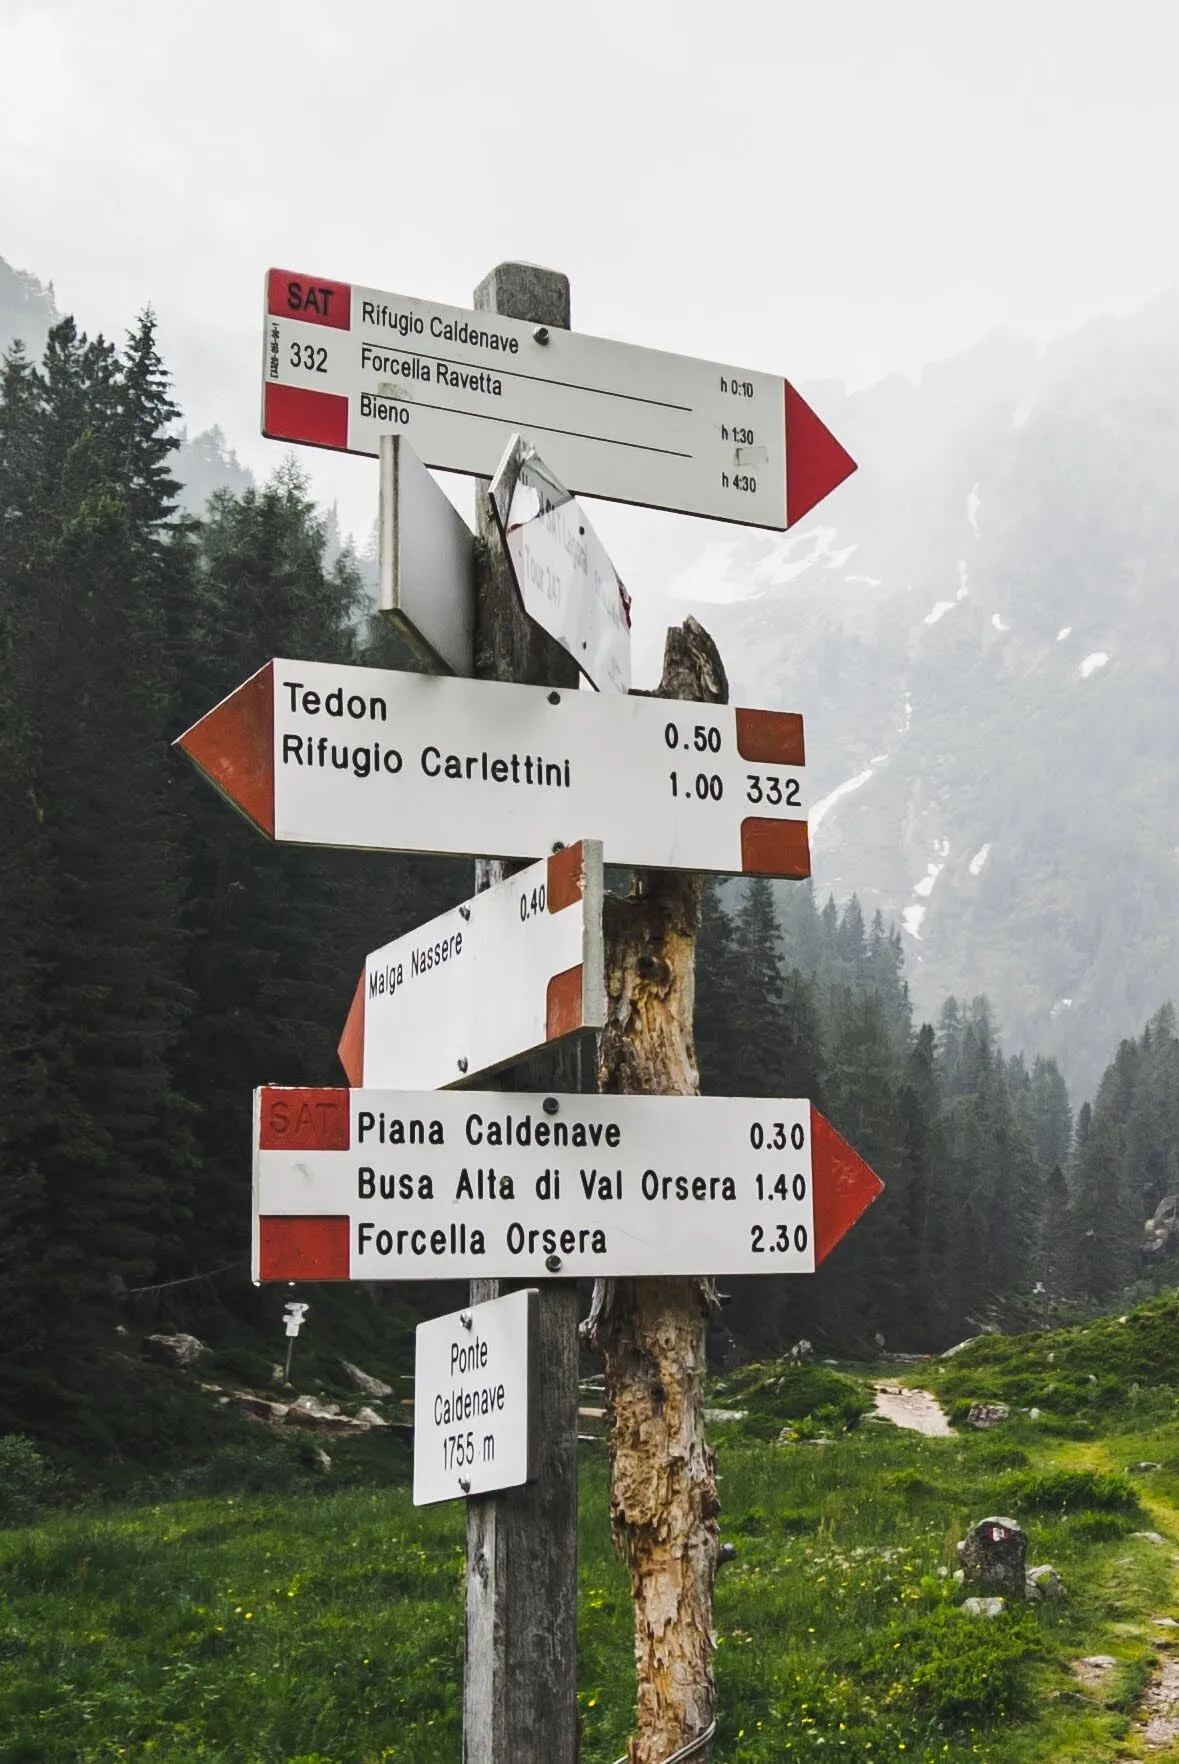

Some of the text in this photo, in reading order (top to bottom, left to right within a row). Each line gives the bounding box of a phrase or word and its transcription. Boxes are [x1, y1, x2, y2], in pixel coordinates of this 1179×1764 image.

[287, 282, 334, 316] SAT
[362, 301, 519, 354] Rifugio Caldenave
[290, 341, 328, 373] 332
[361, 347, 502, 396] Forcella Ravetta
[720, 376, 754, 398] h 0:10
[360, 395, 410, 425] Bieno
[721, 425, 754, 445] h 1:30
[721, 472, 757, 493] h 4:30
[283, 682, 387, 721] Tedon
[664, 723, 722, 754] 0.50
[282, 734, 571, 788] Rifugio Carlettini
[669, 772, 724, 802] 1.00
[746, 775, 802, 807] 332
[520, 885, 545, 922] 0.40
[369, 932, 463, 999] Malga Nassere
[269, 1102, 337, 1134] SAT
[358, 1111, 805, 1151] Piana Caldenave 0.30
[358, 1167, 806, 1202] Busa Alta di Val Orsera 1.40
[358, 1223, 808, 1256] Forcella Orsera 2.30
[450, 1336, 488, 1376] Ponte
[434, 1384, 505, 1426] Caldenave
[443, 1431, 495, 1471] 1755 m
